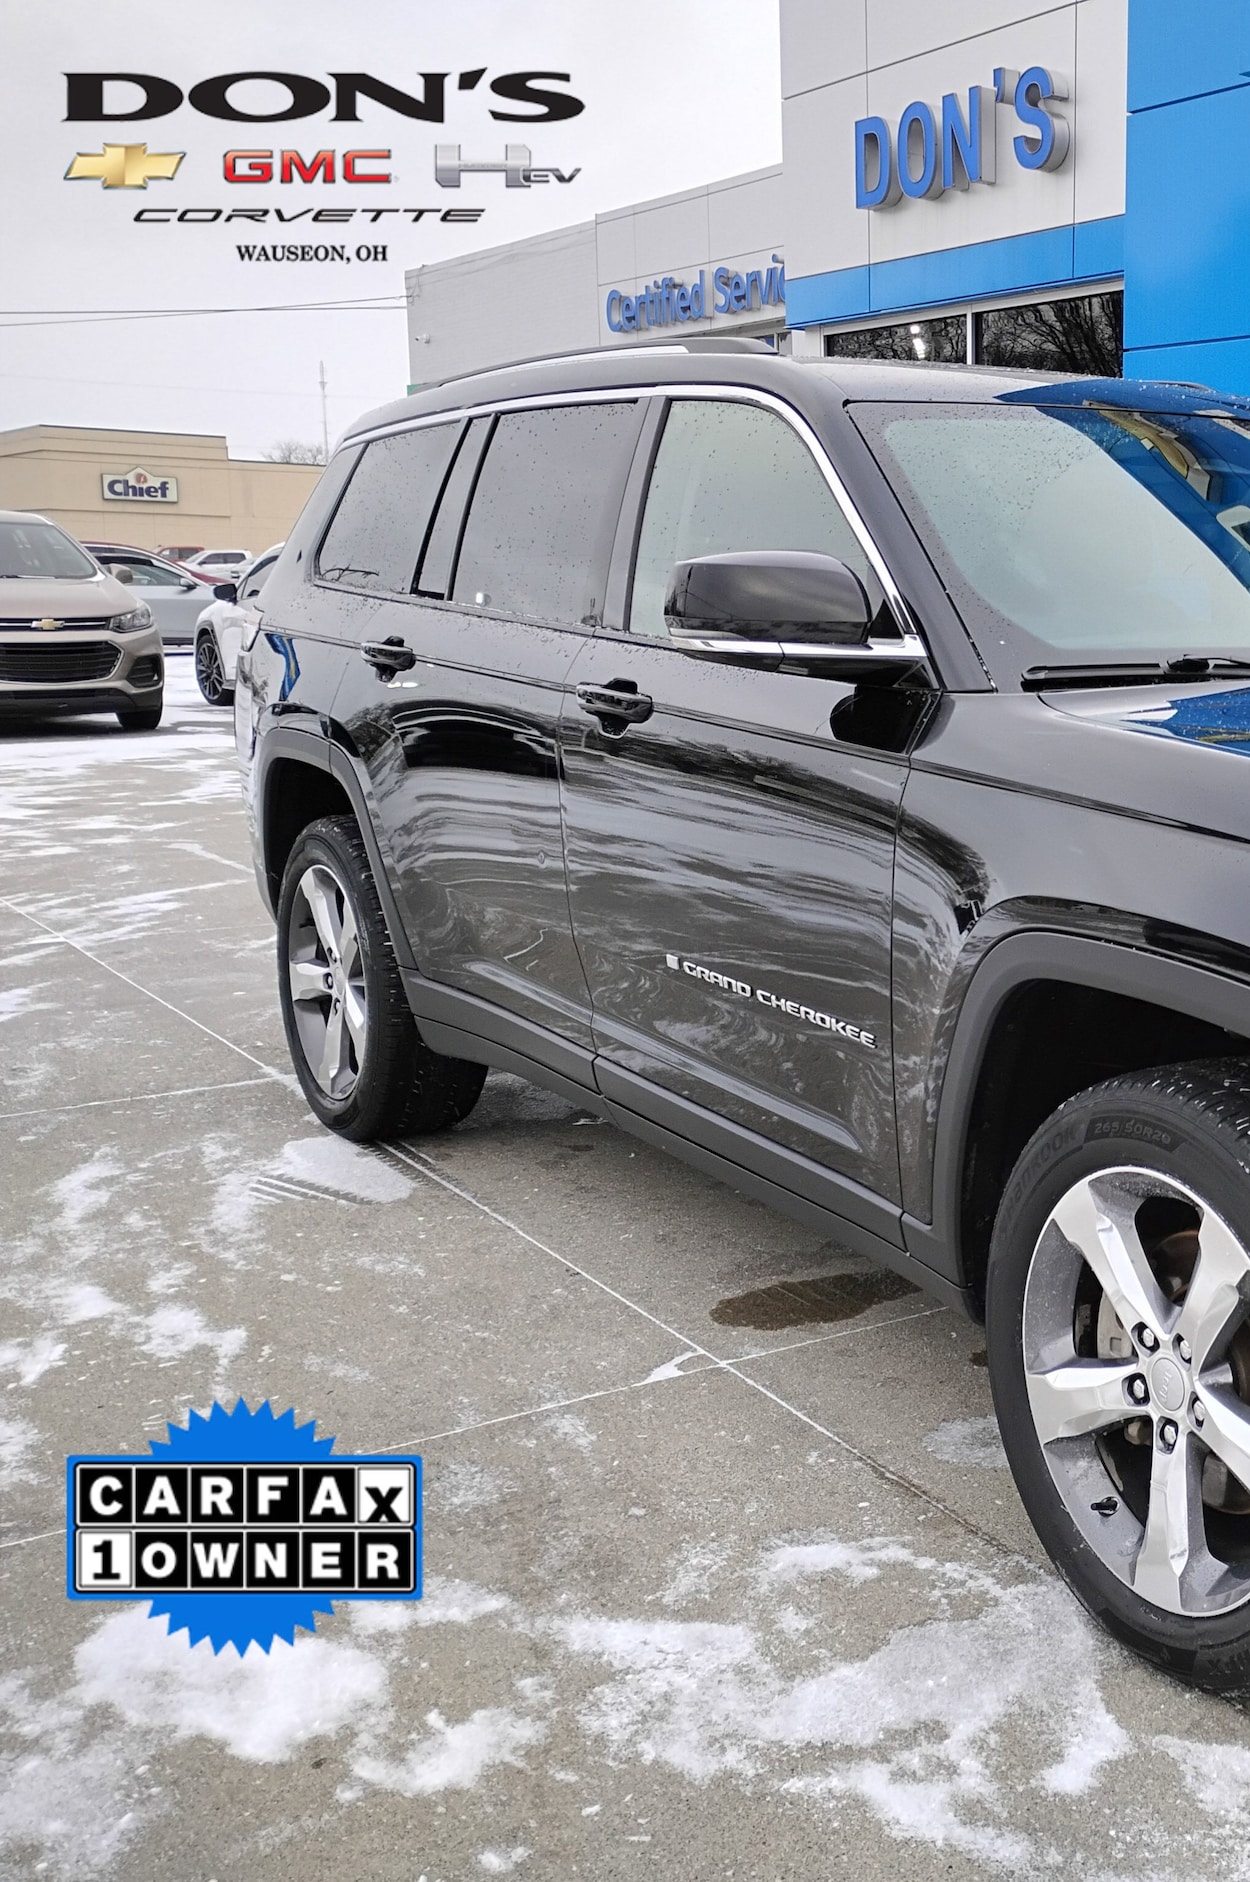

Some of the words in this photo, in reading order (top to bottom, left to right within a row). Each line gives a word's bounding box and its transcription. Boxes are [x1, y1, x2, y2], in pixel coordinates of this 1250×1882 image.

[855, 66, 1062, 209] DON'S
[606, 269, 705, 333] Certified
[107, 479, 169, 498] Chief
[682, 961, 752, 998] GRAND
[756, 989, 878, 1049] CHEROKEE
